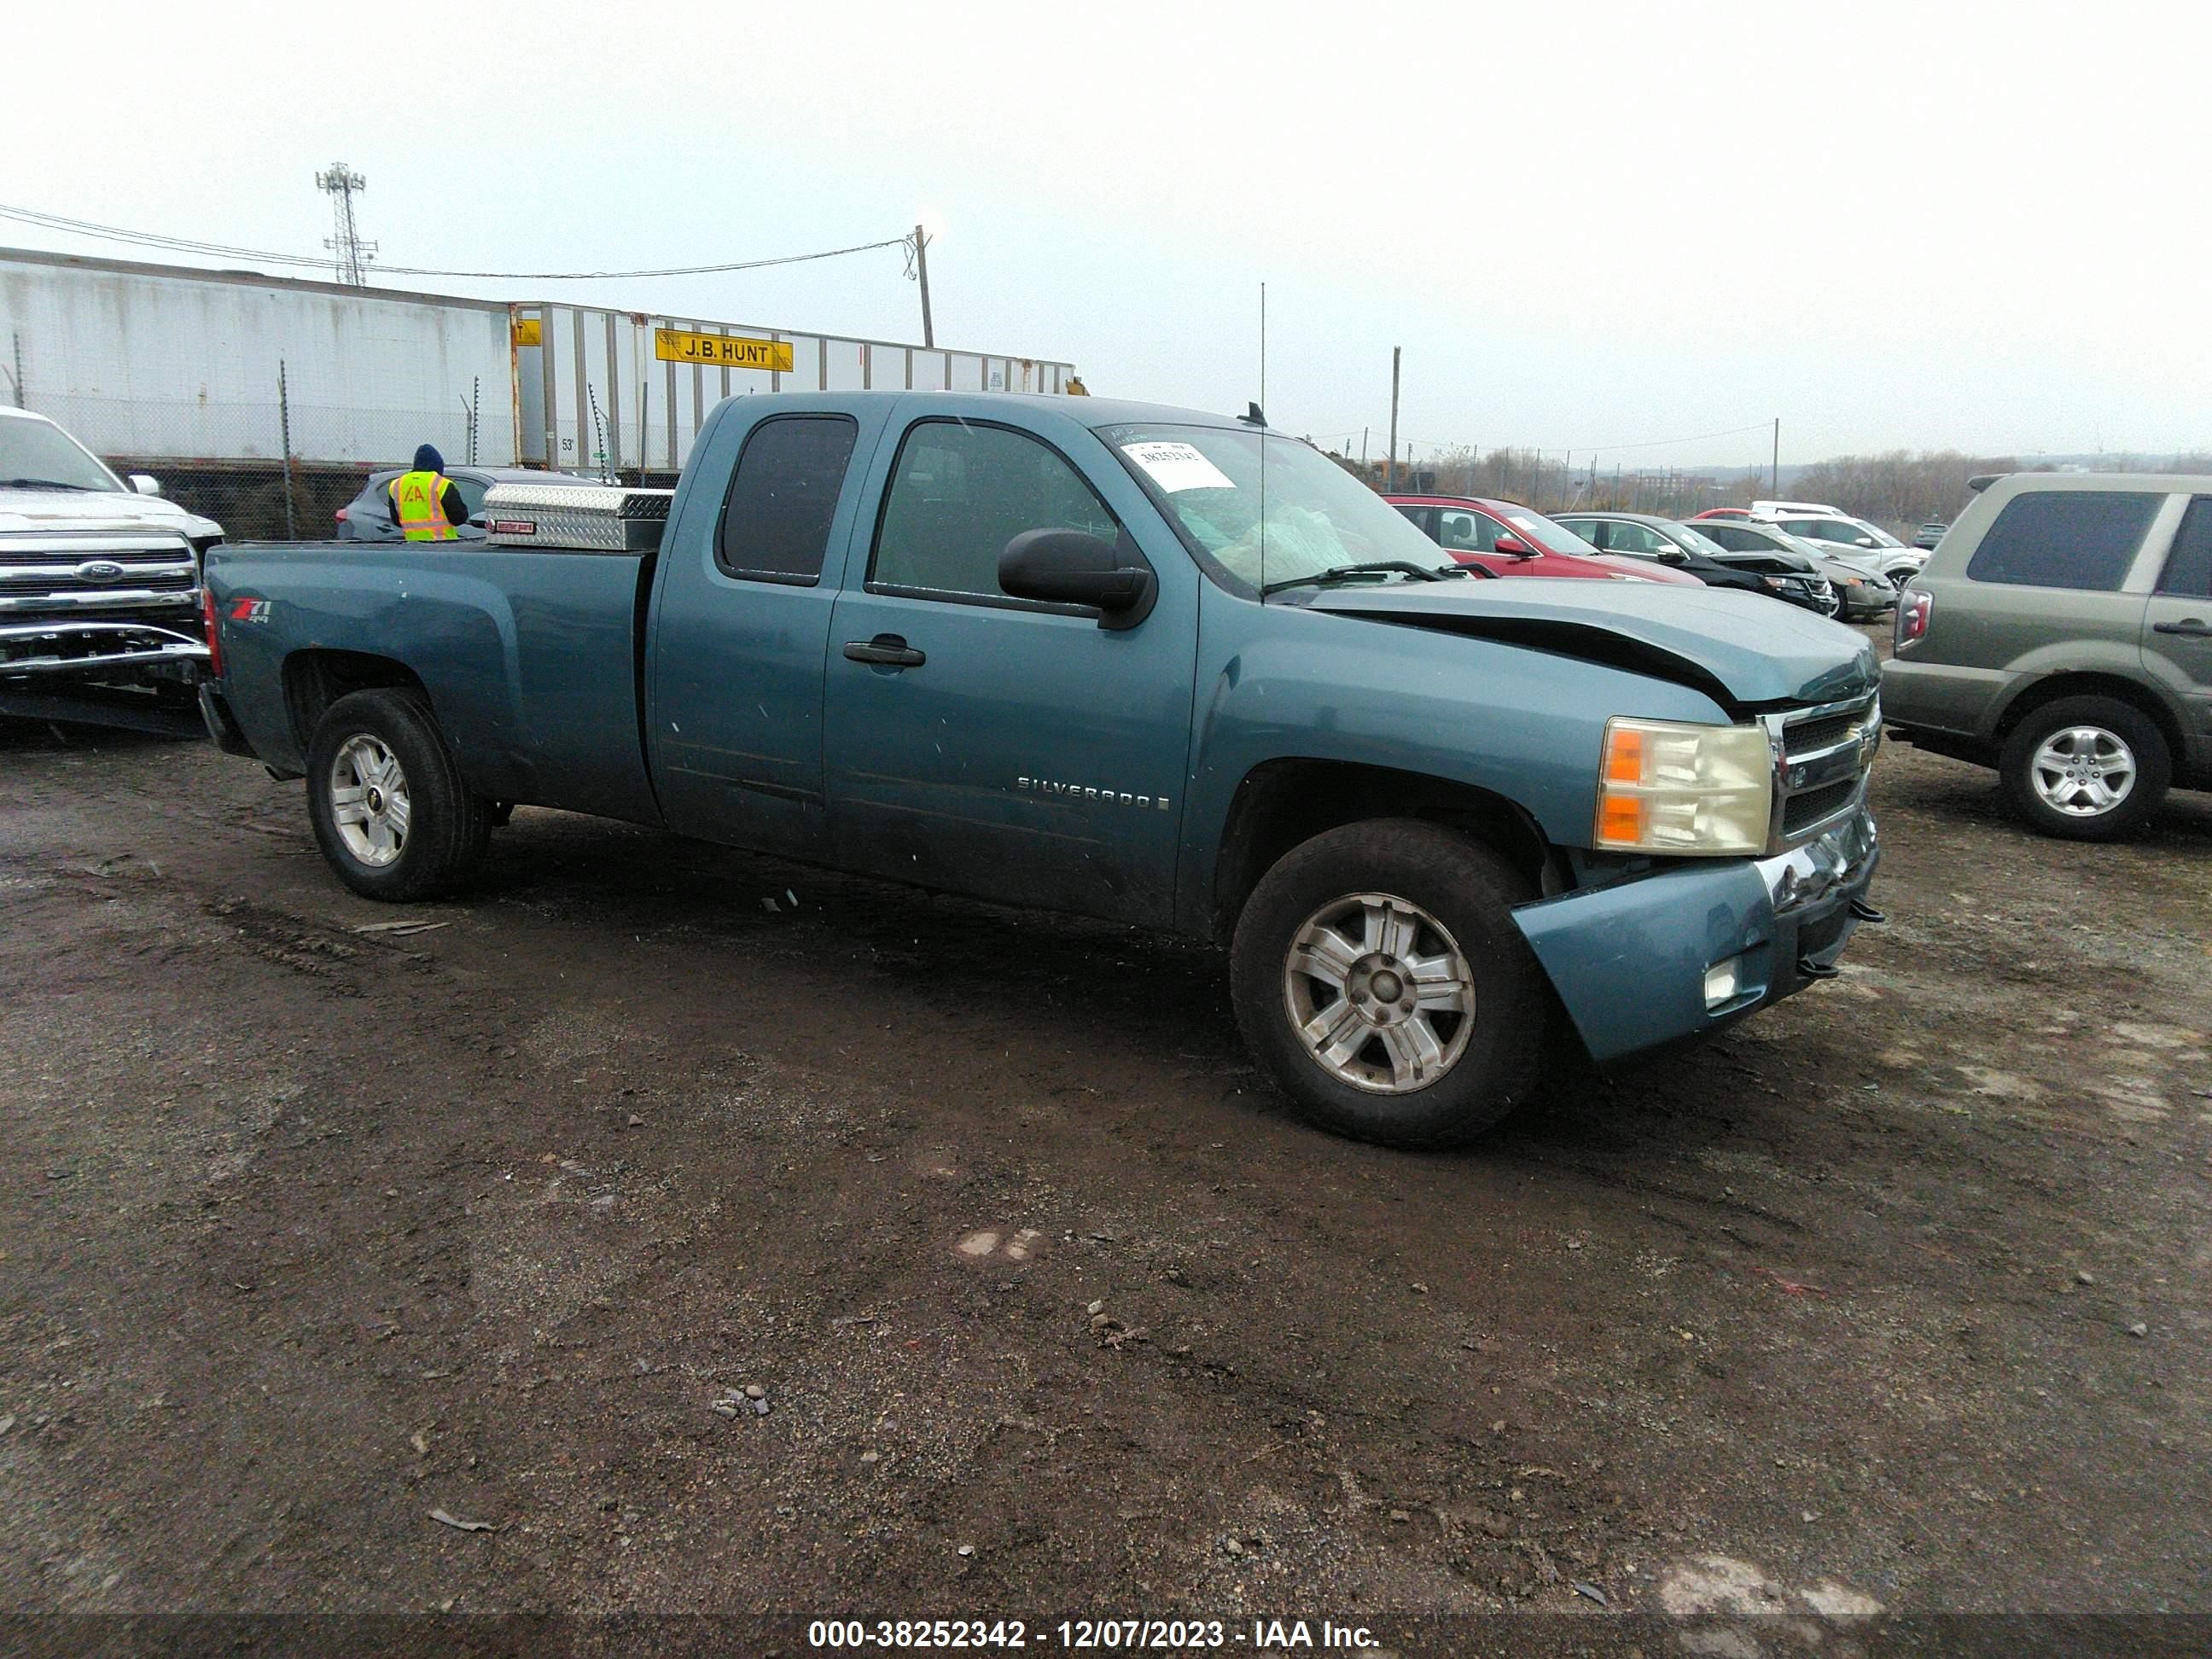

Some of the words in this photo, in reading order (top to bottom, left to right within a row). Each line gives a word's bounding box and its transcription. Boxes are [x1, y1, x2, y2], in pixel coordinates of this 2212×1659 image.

[685, 340, 717, 358] J.B.
[722, 343, 768, 363] HUNT
[231, 597, 272, 620] Z71
[1017, 777, 1150, 807] SILVERADO
